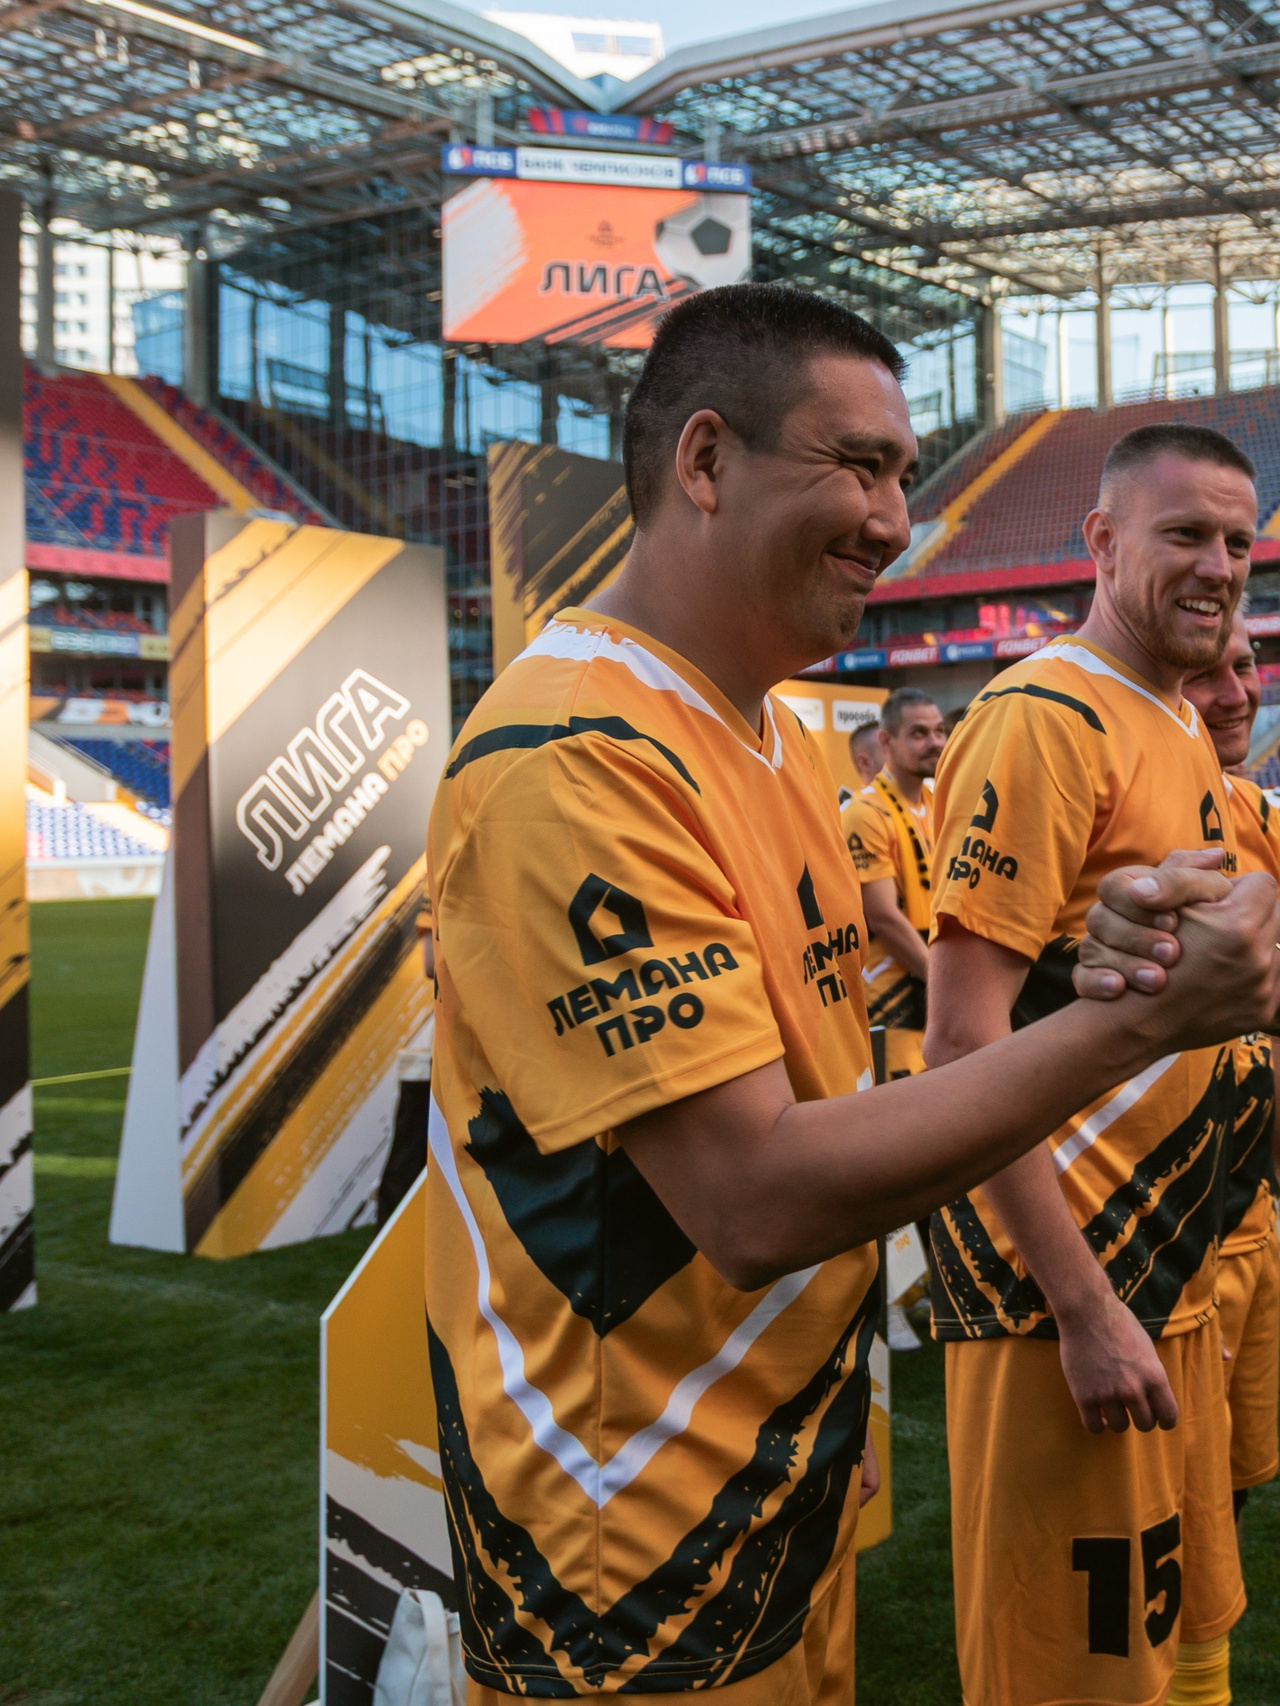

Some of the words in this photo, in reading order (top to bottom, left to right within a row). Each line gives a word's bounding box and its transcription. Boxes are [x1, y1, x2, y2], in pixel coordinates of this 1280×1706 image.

[540, 261, 668, 301] ЛИГА
[236, 668, 411, 872] ЛИГА
[284, 772, 390, 897] ЛЕМАНА
[377, 718, 430, 782] ПРО
[961, 836, 1019, 881] АНА
[547, 942, 740, 1037] ЛЕМАНА
[803, 922, 860, 985] ЛЕМНА
[595, 992, 705, 1058] ПРО
[1071, 1512, 1184, 1659] 15
